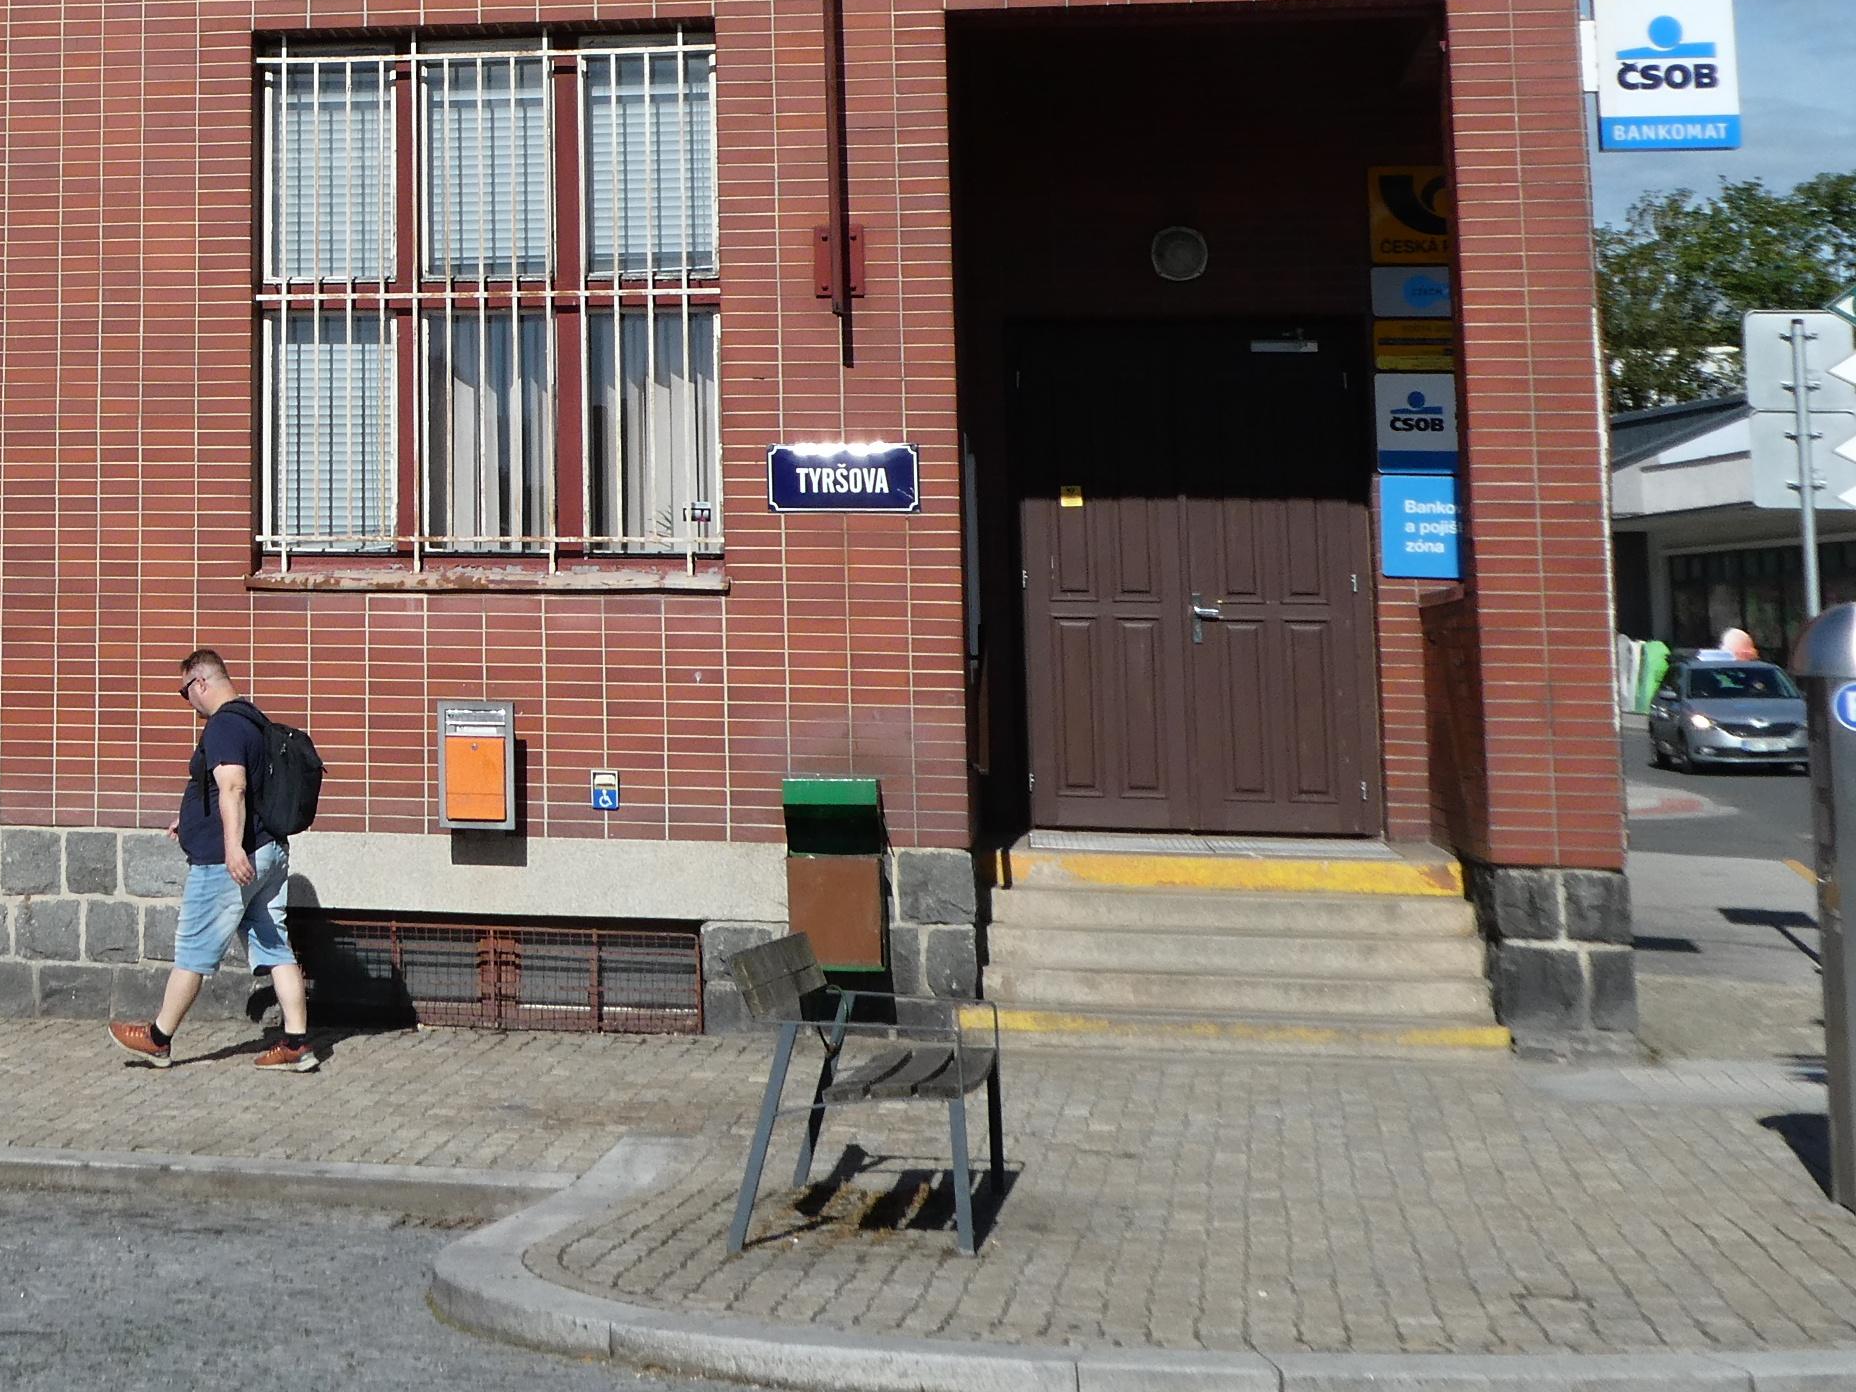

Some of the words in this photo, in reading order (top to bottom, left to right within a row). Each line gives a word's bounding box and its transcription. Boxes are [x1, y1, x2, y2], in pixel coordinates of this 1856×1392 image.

[1617, 62, 1719, 90] ČSOB
[1613, 123, 1729, 141] BANKOMAT
[1380, 237, 1438, 254] ČESKÁ
[1390, 416, 1445, 432] ČSOB
[795, 463, 890, 494] TYRŠOVA
[1405, 522, 1415, 533] a
[1405, 539, 1445, 553] zóna
